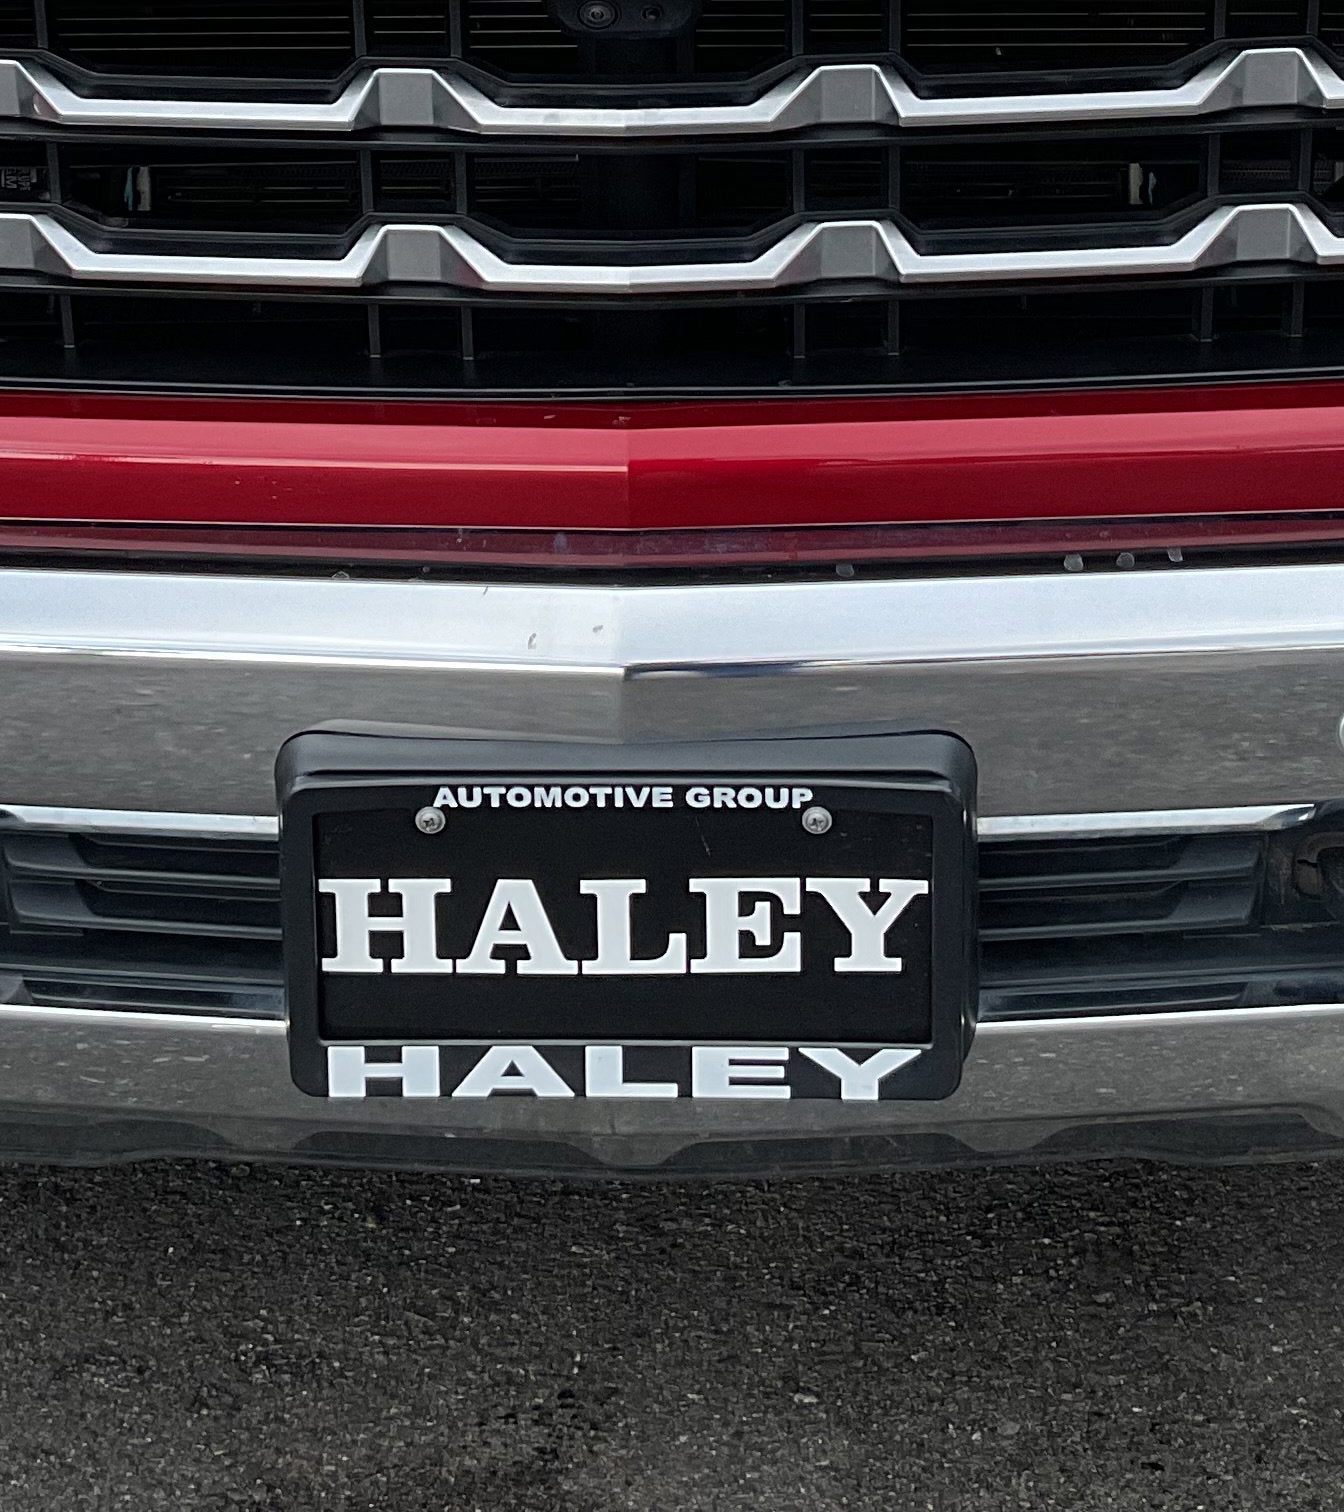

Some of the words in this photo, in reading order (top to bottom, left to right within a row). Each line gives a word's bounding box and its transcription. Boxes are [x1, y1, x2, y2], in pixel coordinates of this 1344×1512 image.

[432, 786, 674, 810] AUTOMOTIVE
[685, 786, 813, 809] GROUP
[317, 877, 929, 975] HALEY
[326, 1045, 923, 1100] HALEY
